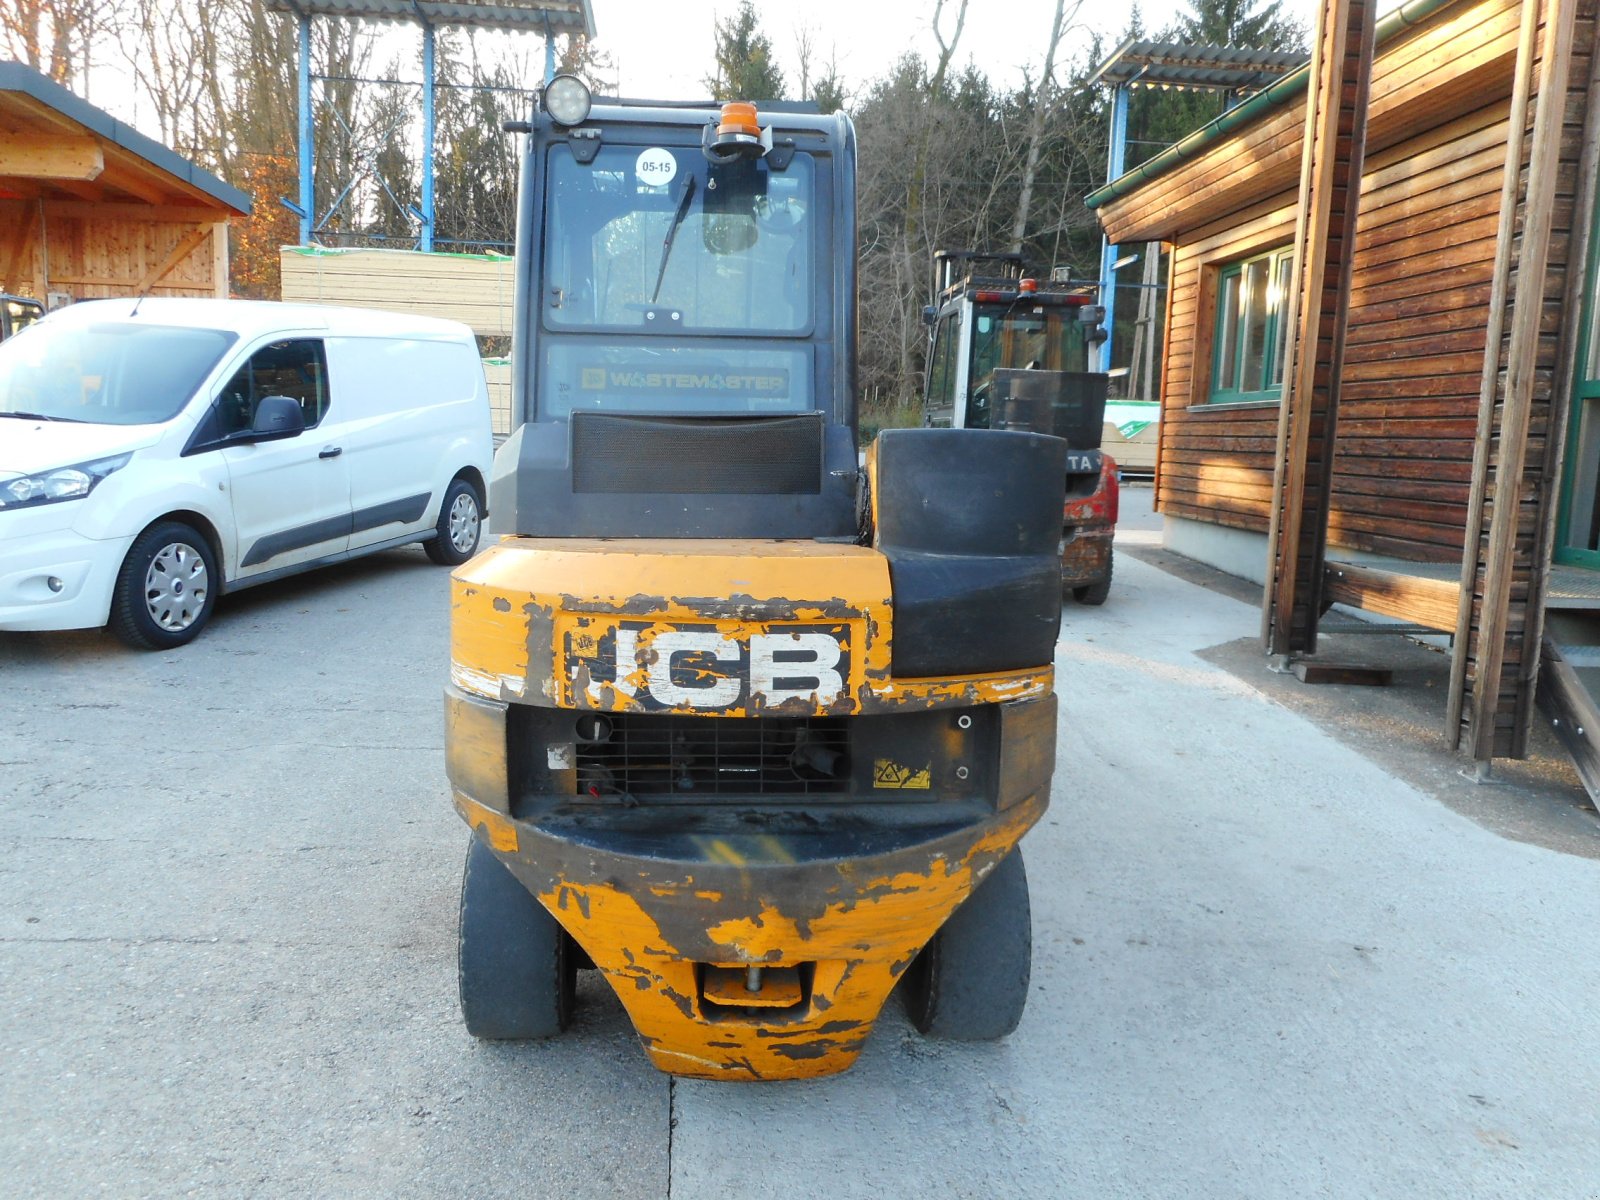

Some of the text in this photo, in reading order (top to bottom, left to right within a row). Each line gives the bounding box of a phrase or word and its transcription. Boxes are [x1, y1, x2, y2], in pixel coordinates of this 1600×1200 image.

[642, 161, 671, 173] 05-15
[610, 371, 785, 391] WASTEMASTER
[571, 629, 843, 708] JCB
